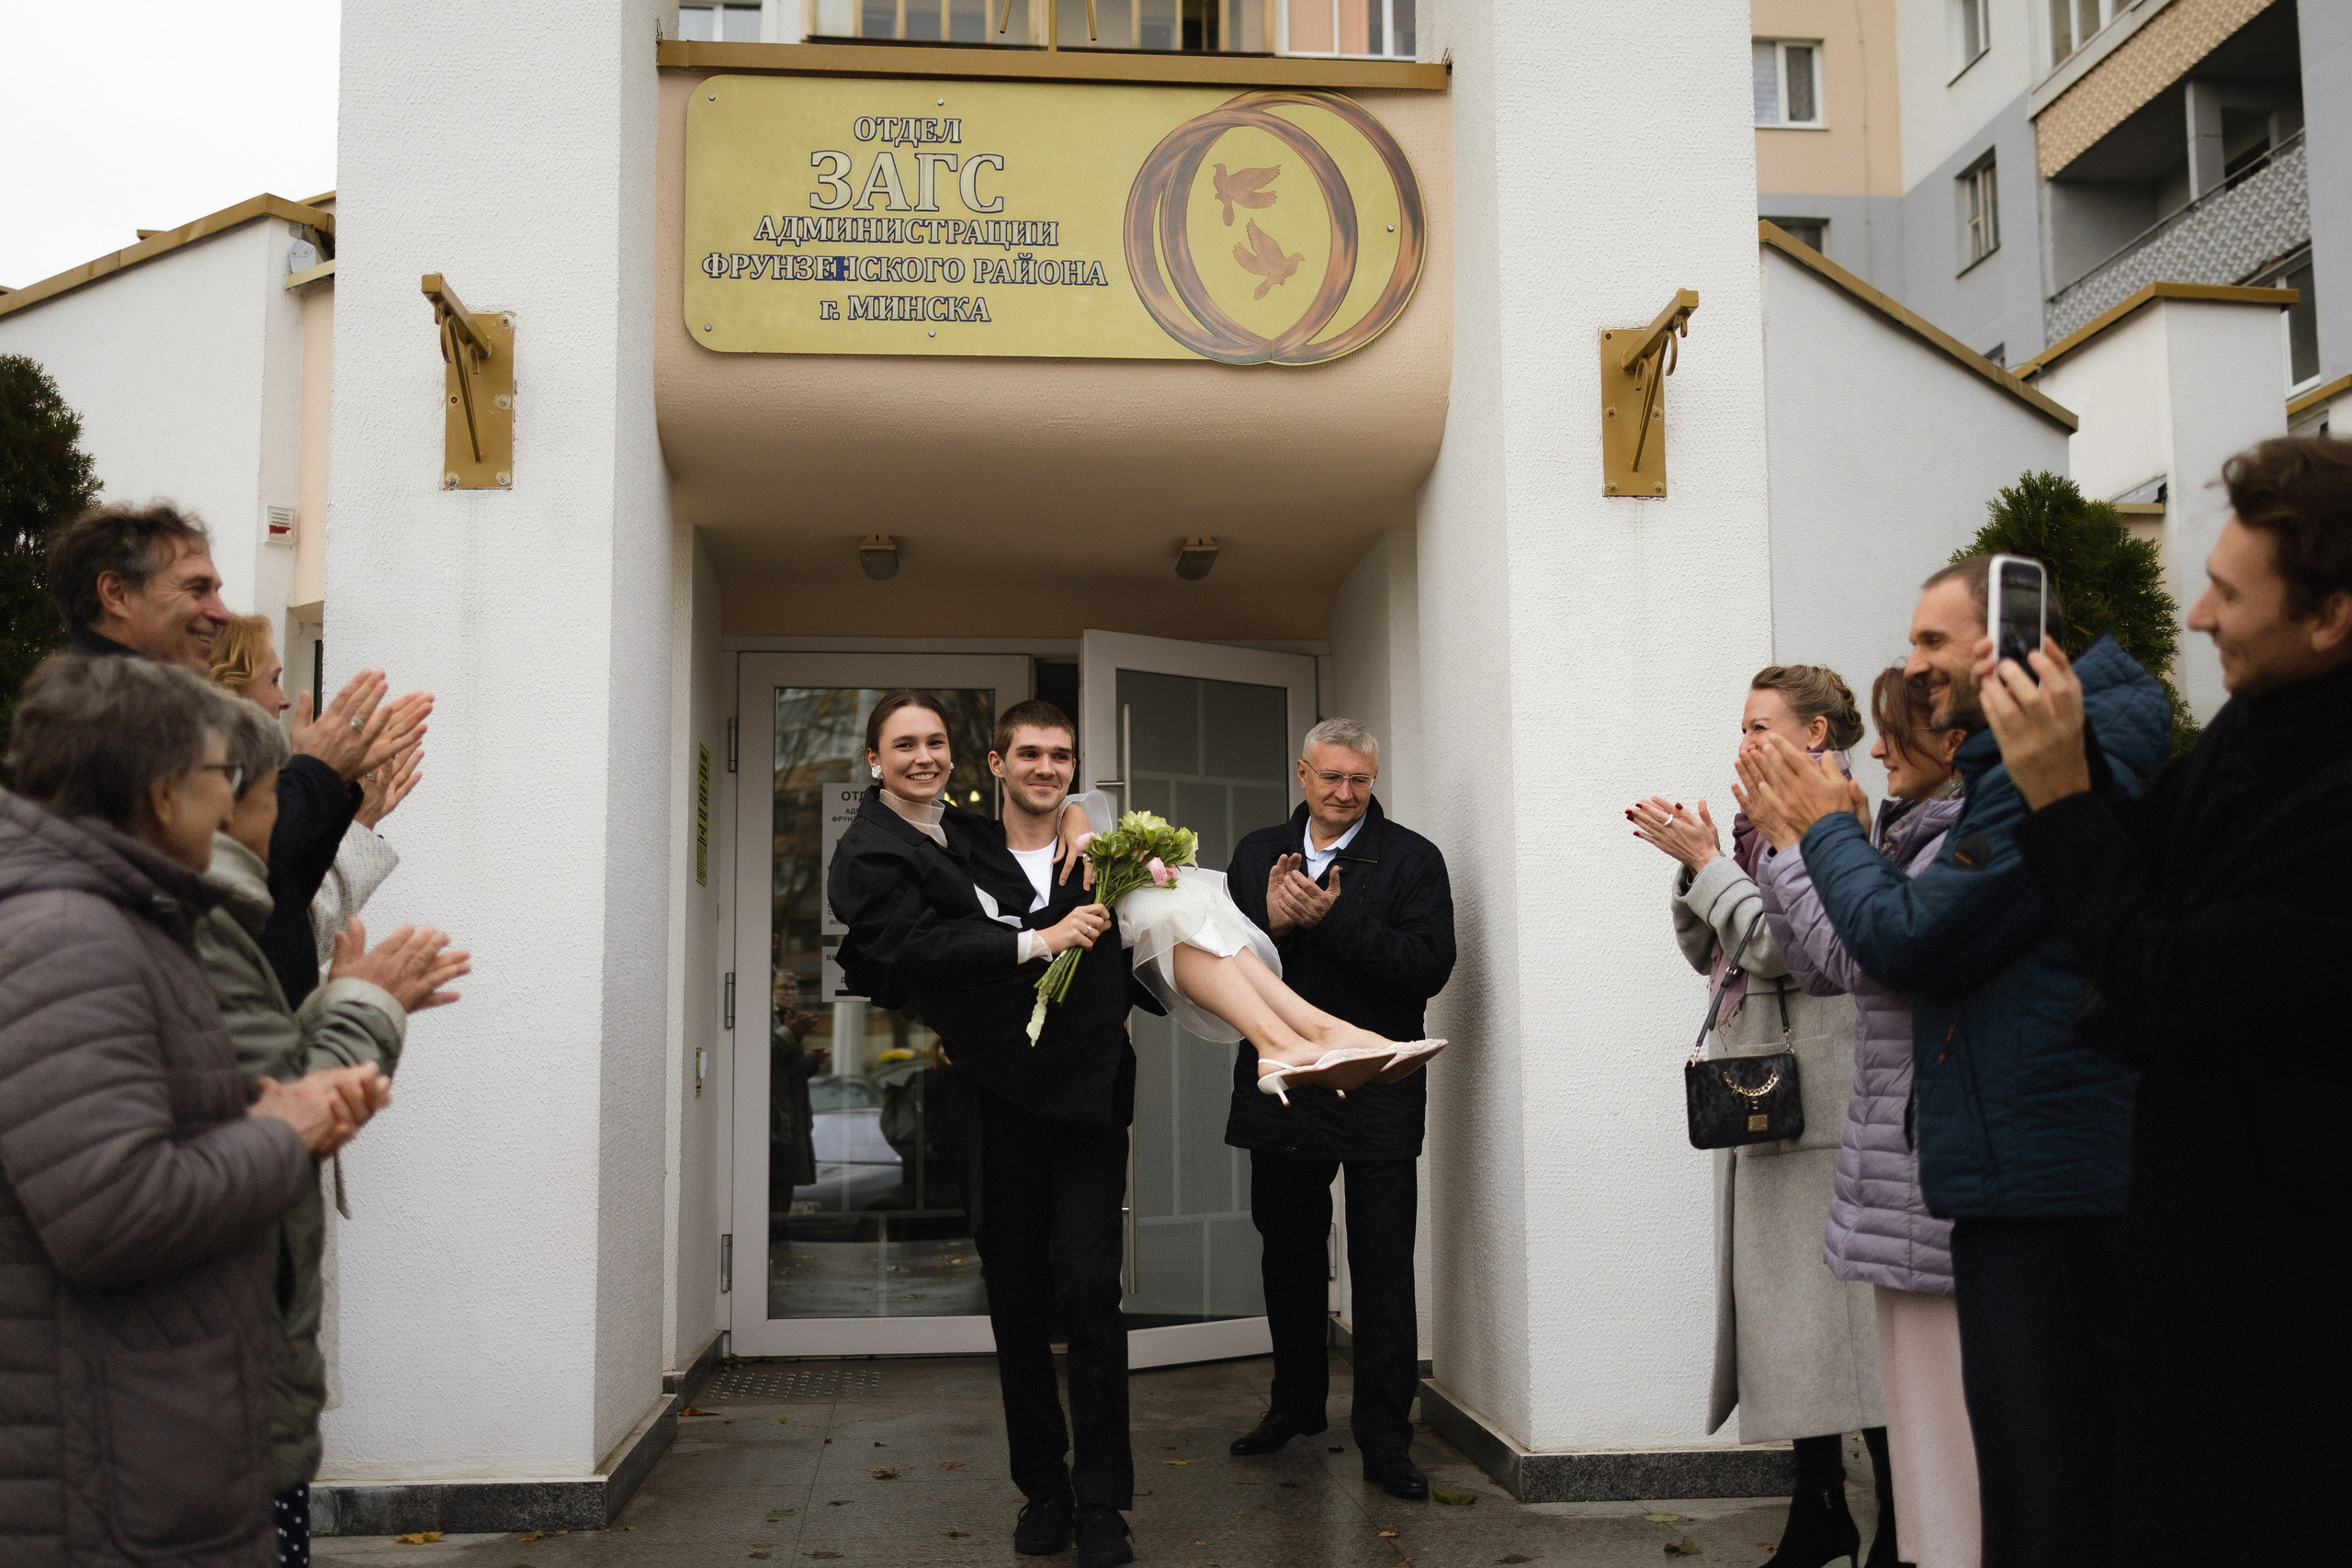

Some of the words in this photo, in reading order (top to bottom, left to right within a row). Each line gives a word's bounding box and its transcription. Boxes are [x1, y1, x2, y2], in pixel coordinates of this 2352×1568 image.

[854, 116, 962, 147] ОТДЕЛ
[809, 150, 1004, 213] ЗАГС
[753, 215, 1059, 250] АДМИНИСТРАЦИИ
[701, 253, 966, 283] ФРУНЗЕНСКОГО
[973, 253, 1108, 286] РАЙОНА
[820, 299, 840, 321] г.
[848, 295, 991, 321] МИНСКА
